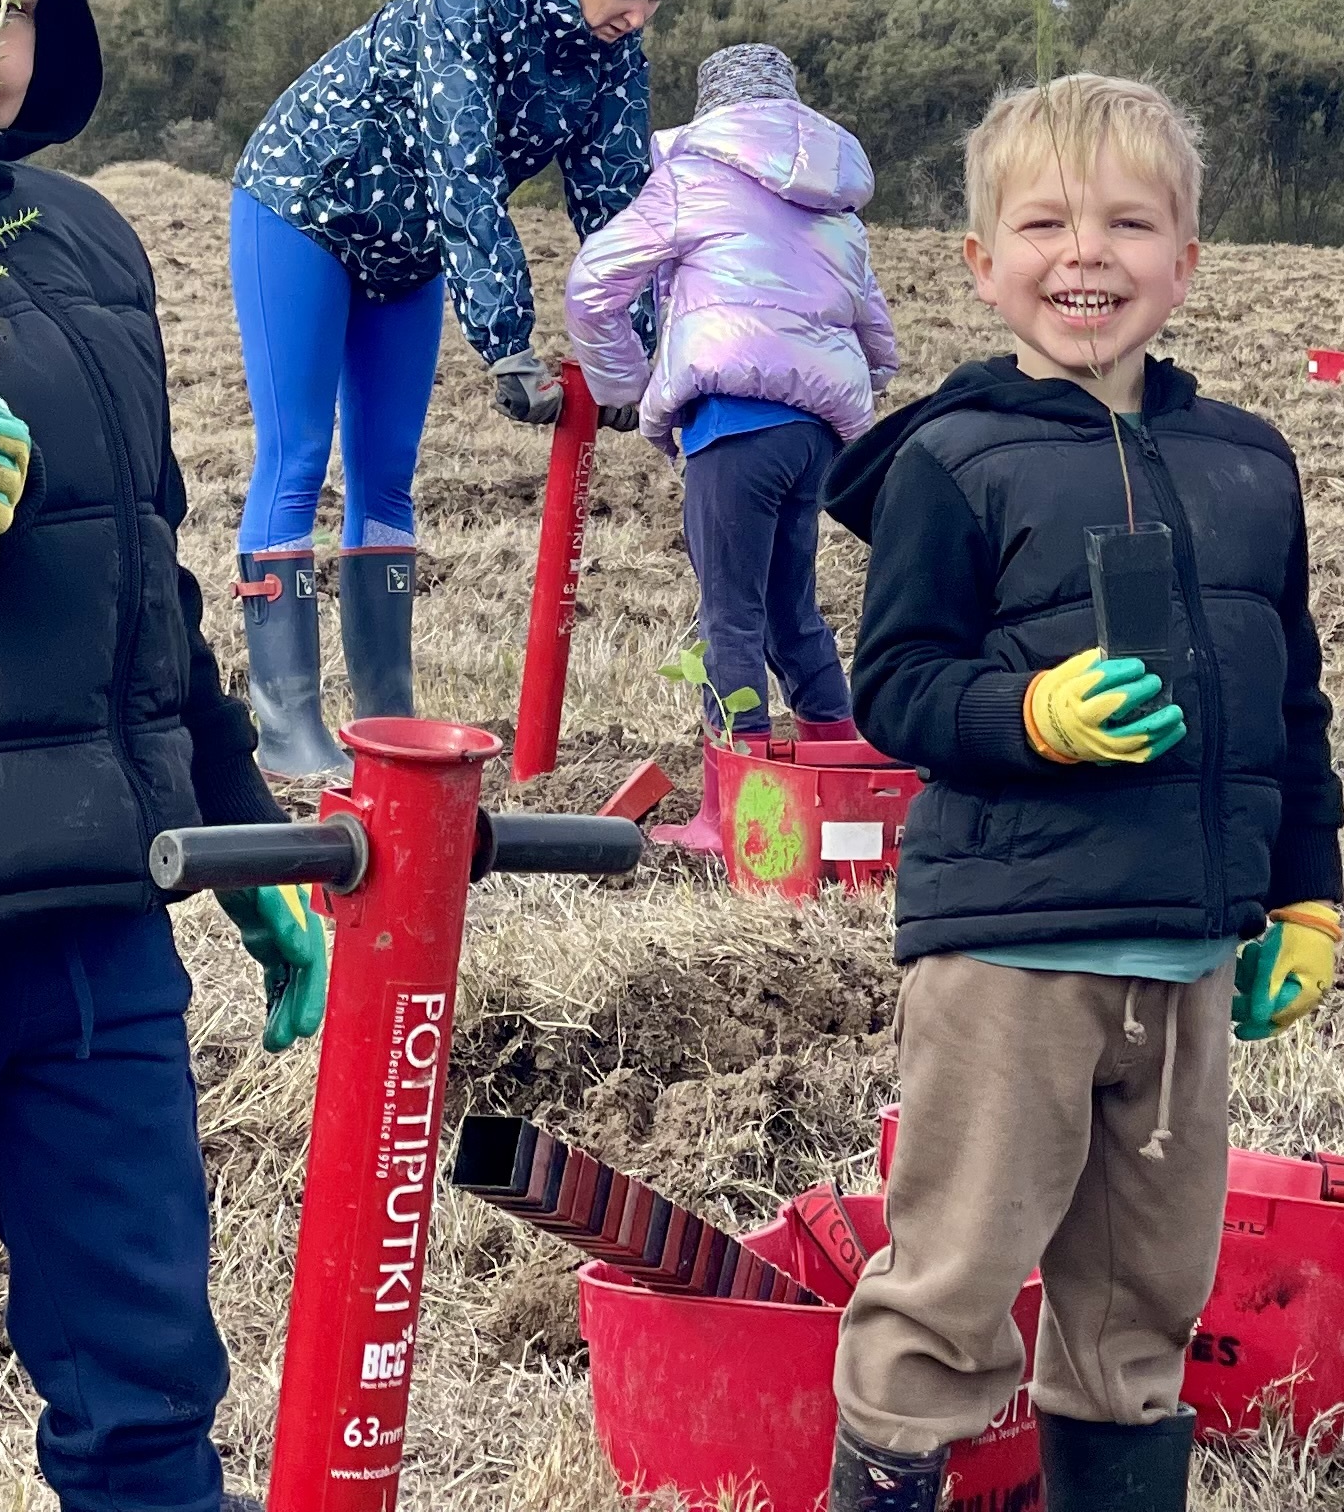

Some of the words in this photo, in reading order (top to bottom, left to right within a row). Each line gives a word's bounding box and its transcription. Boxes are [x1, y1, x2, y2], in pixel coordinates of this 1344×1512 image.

[391, 993, 409, 1045] Finnish
[384, 1050, 403, 1098] Design
[380, 1102, 397, 1141] Since
[374, 993, 446, 1313] POTTIPUTKI
[375, 1146, 391, 1179] 1970
[361, 1341, 408, 1380] BCC
